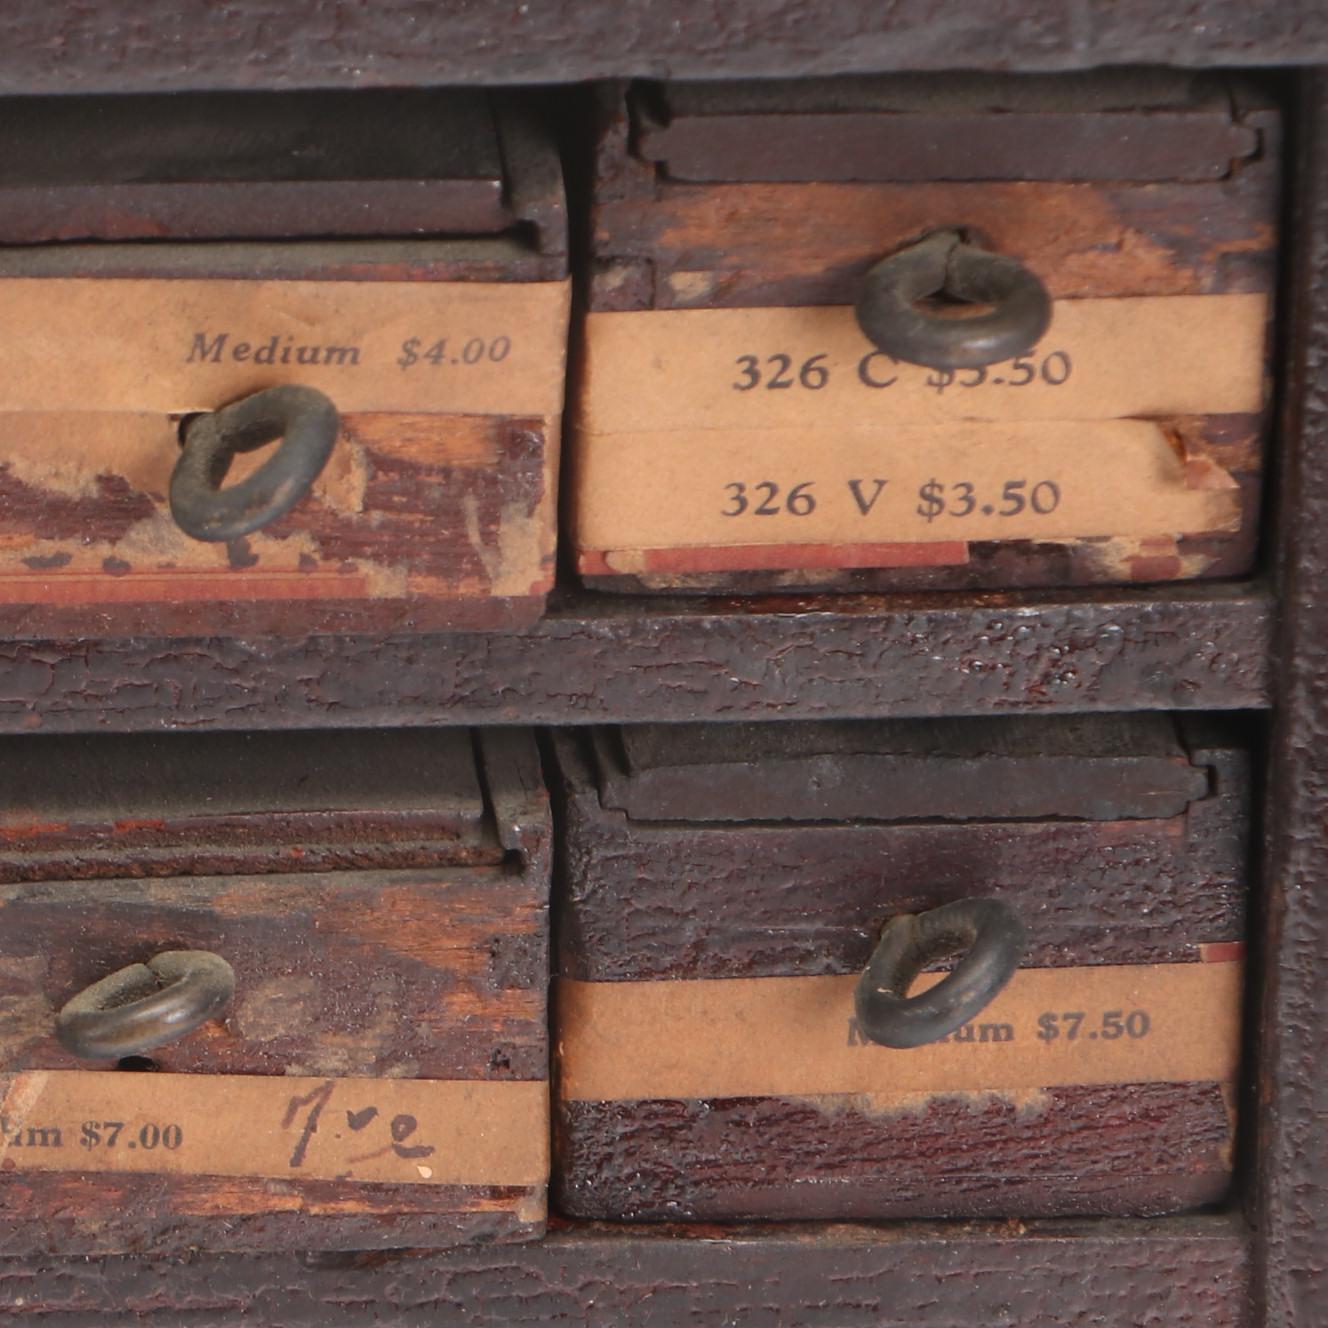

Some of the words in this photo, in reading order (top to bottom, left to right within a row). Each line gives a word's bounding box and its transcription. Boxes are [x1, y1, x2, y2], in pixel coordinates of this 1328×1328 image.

[186, 332, 360, 366] Medium
[396, 335, 511, 372] $4.00
[733, 352, 830, 392] 326
[854, 350, 902, 392] C
[721, 481, 817, 517] 326
[847, 478, 889, 517] V
[916, 477, 1061, 524] $3.50
[1036, 1009, 1152, 1046] $7.50
[79, 1120, 183, 1153] $7.00
